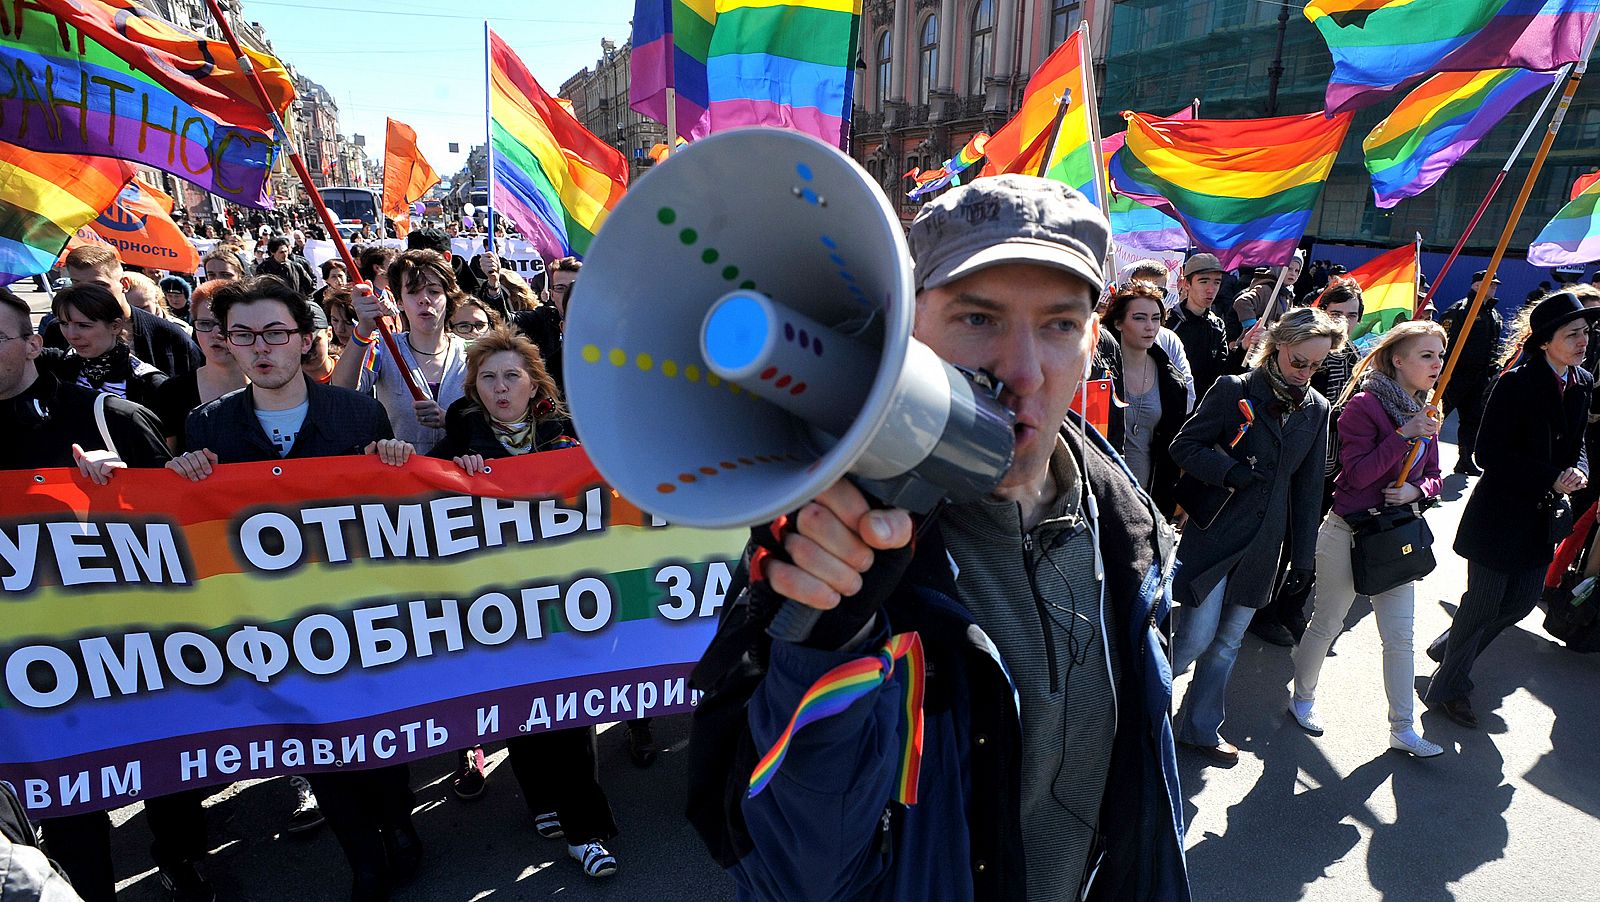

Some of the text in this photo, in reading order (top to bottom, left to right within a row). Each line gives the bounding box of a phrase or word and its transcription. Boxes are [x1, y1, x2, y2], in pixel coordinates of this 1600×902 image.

[0, 487, 602, 591] УЕМ ОТМЕНЫ
[5, 562, 732, 708] ОМОФОБНОГО ЗА
[1, 760, 142, 809] вим
[181, 719, 449, 781] ненависть
[476, 705, 499, 736] и
